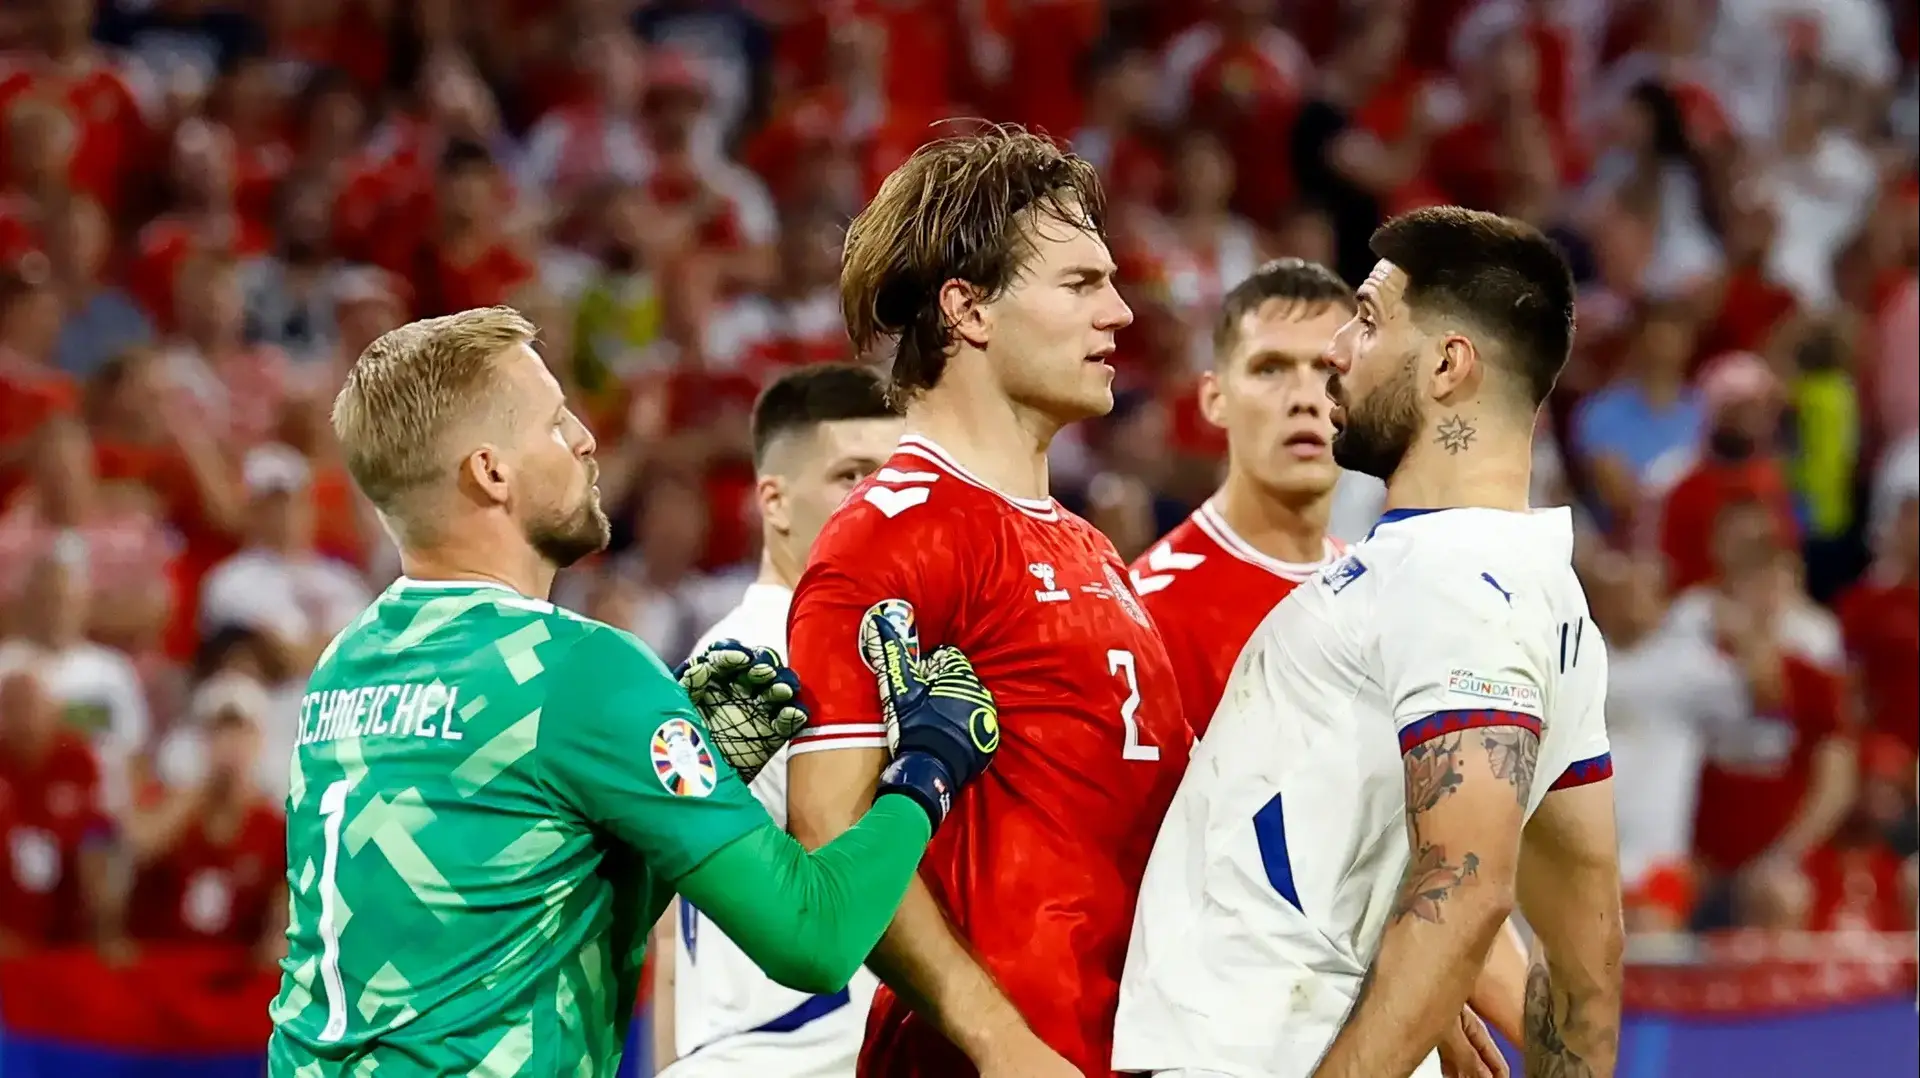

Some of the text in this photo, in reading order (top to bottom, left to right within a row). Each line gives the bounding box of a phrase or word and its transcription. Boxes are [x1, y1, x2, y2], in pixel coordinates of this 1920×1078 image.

[884, 640, 908, 695] uhlsport
[1449, 677, 1537, 699] FOUNDATION
[1451, 668, 1474, 678] UEFA
[295, 684, 463, 741] SCHMEICHEL
[1107, 648, 1160, 761] 2
[318, 779, 351, 1042] 1
